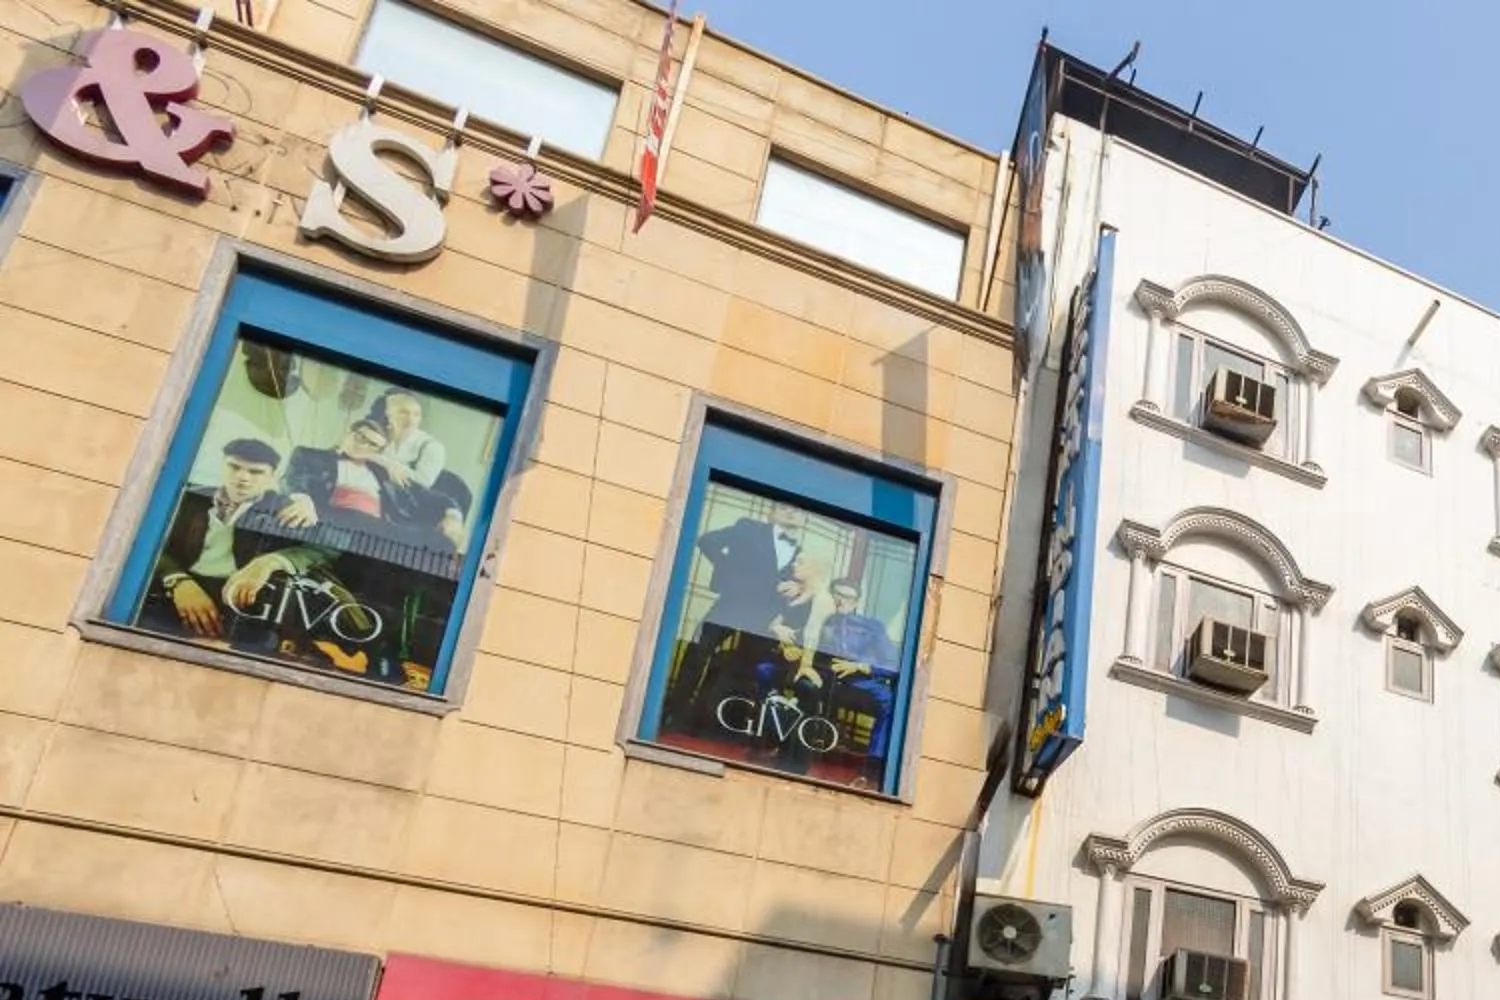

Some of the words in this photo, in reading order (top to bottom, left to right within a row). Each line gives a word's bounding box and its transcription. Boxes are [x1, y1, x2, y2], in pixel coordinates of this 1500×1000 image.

[301, 122, 460, 263] S
[226, 574, 383, 643] GIVO
[716, 693, 839, 752] GIVO
